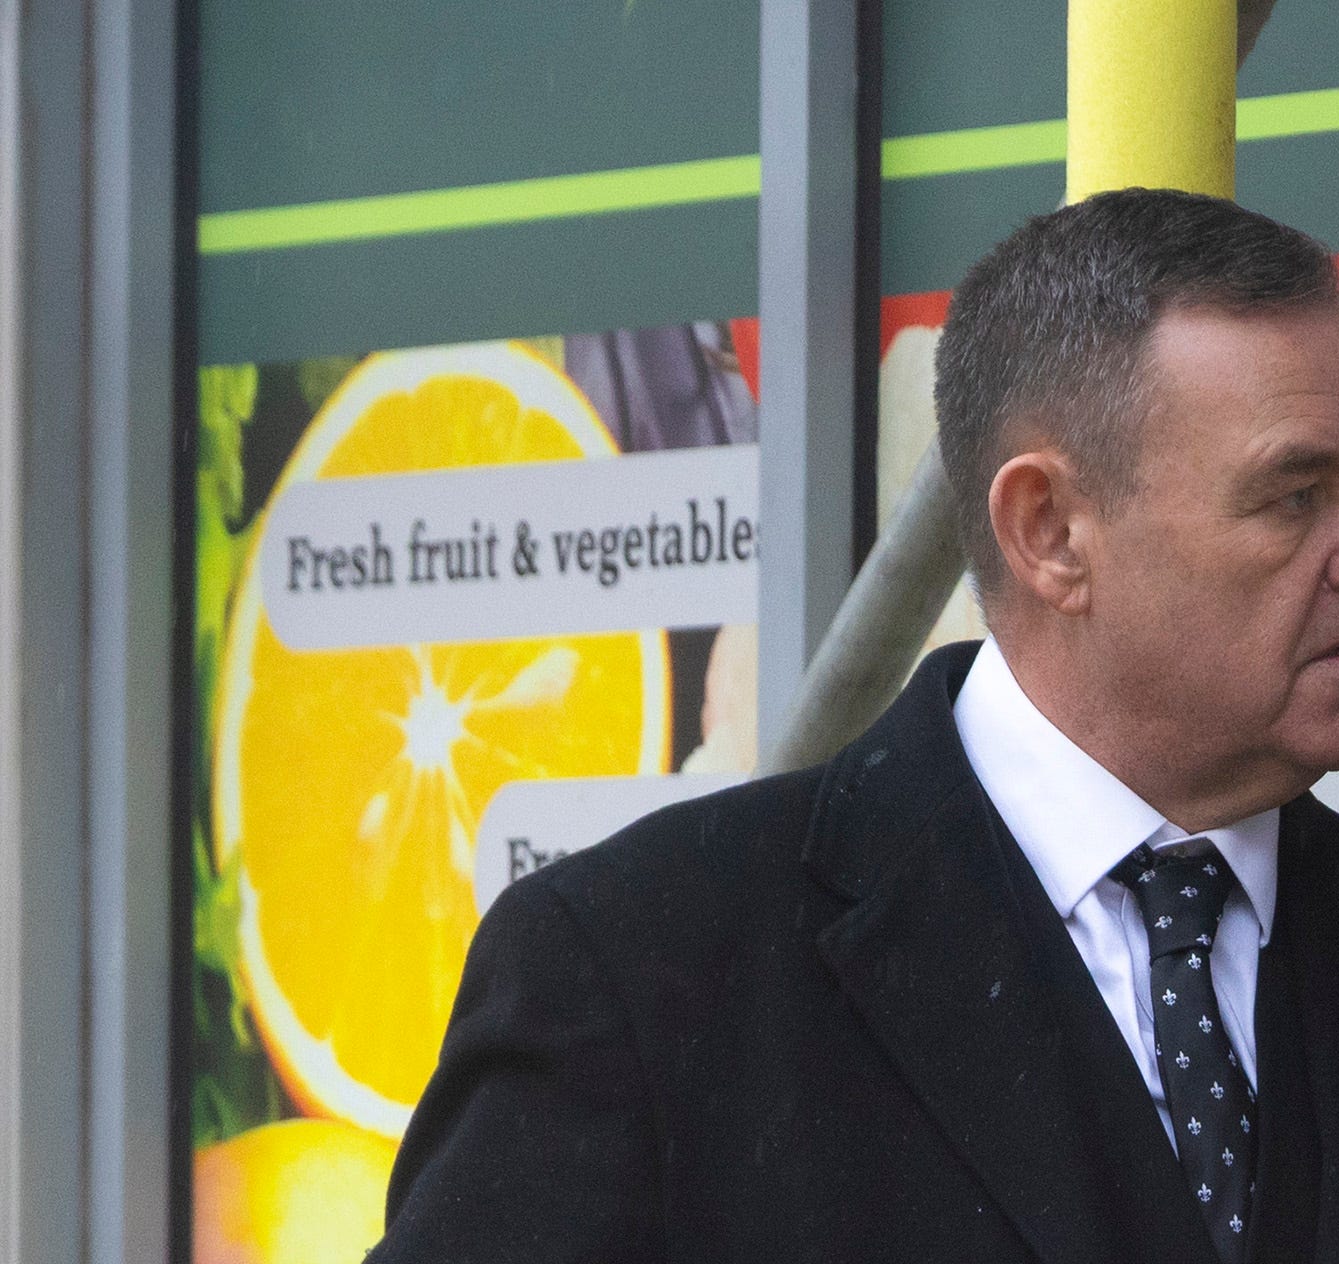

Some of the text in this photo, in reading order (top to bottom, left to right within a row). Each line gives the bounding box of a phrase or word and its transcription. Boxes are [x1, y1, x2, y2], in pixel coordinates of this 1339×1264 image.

[287, 496, 758, 592] Fresh fruit & vegetable
